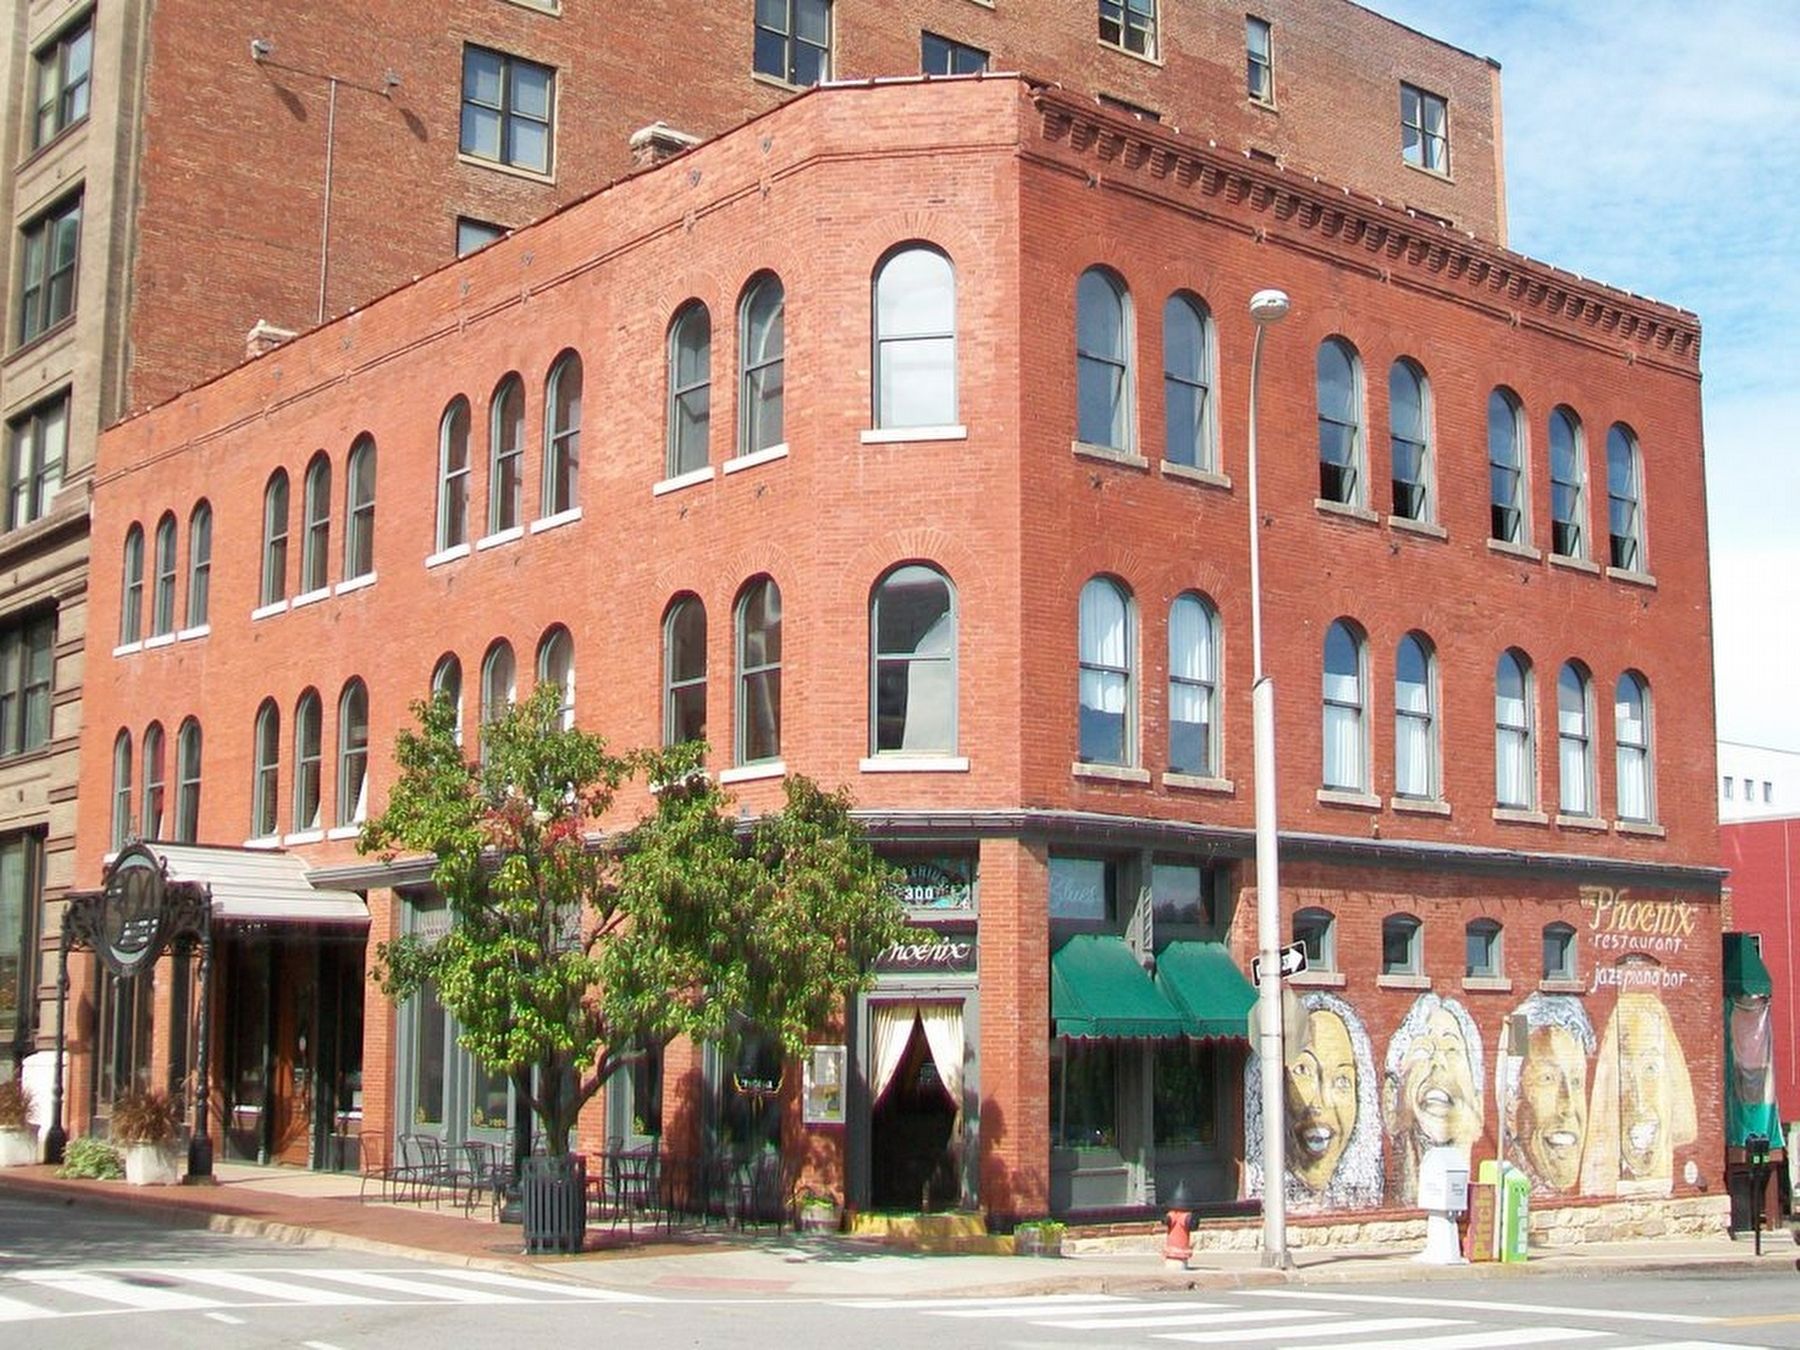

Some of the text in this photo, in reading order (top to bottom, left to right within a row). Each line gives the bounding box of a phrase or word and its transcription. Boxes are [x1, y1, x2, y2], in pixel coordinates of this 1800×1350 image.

[905, 887, 934, 900] 300
[1580, 885, 1699, 937] Phoenix
[1594, 933, 1682, 953] restaurant
[1662, 965, 1688, 987] bar
